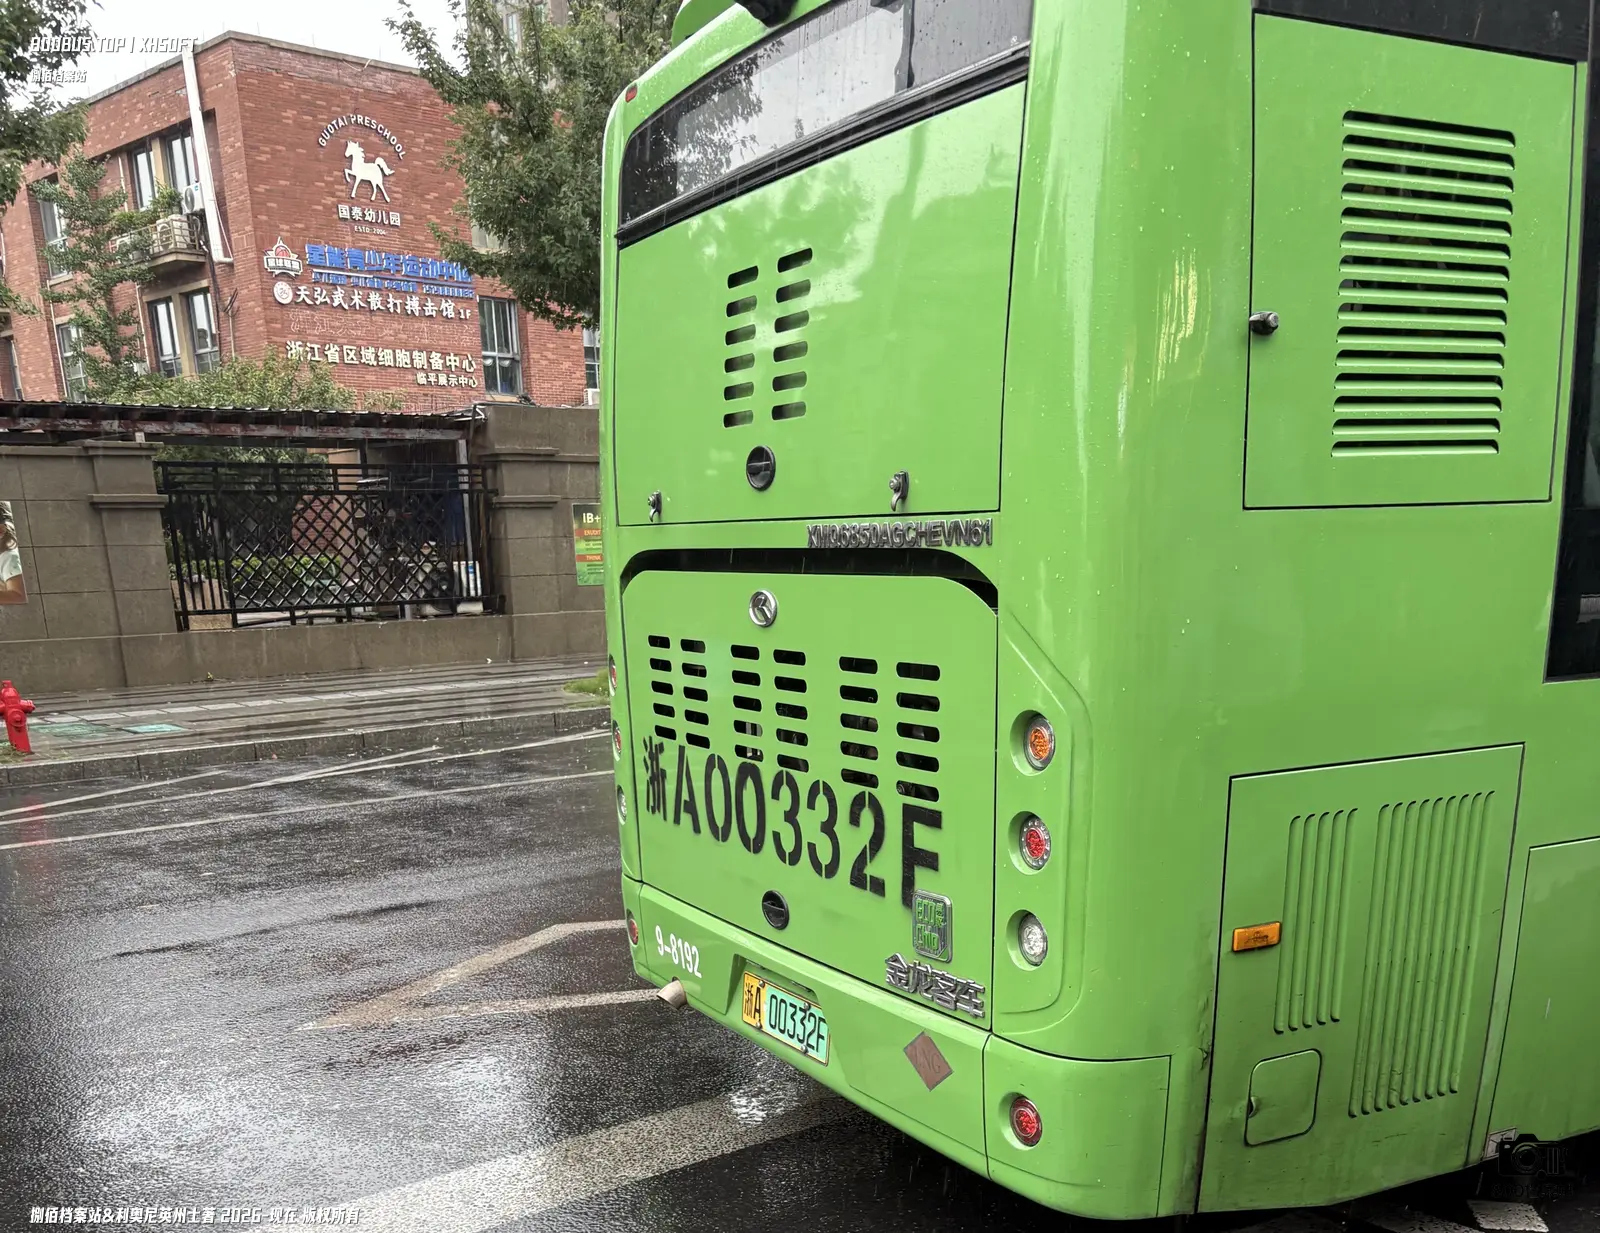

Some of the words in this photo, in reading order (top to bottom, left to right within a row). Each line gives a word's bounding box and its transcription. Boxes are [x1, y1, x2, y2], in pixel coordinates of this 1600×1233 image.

[318, 115, 348, 147] GUOTAI
[350, 113, 406, 160] PRESCHOOL
[337, 203, 401, 227] 国泰幼儿园
[295, 285, 455, 319] 天弘武术散打搏击馆
[285, 340, 477, 373] 浙江省区域细胞制备中心
[416, 372, 478, 388] 临平展示中心
[642, 734, 943, 913] 浙A00332F
[655, 924, 702, 979] 9-8192
[884, 952, 986, 1019] 金龙客车
